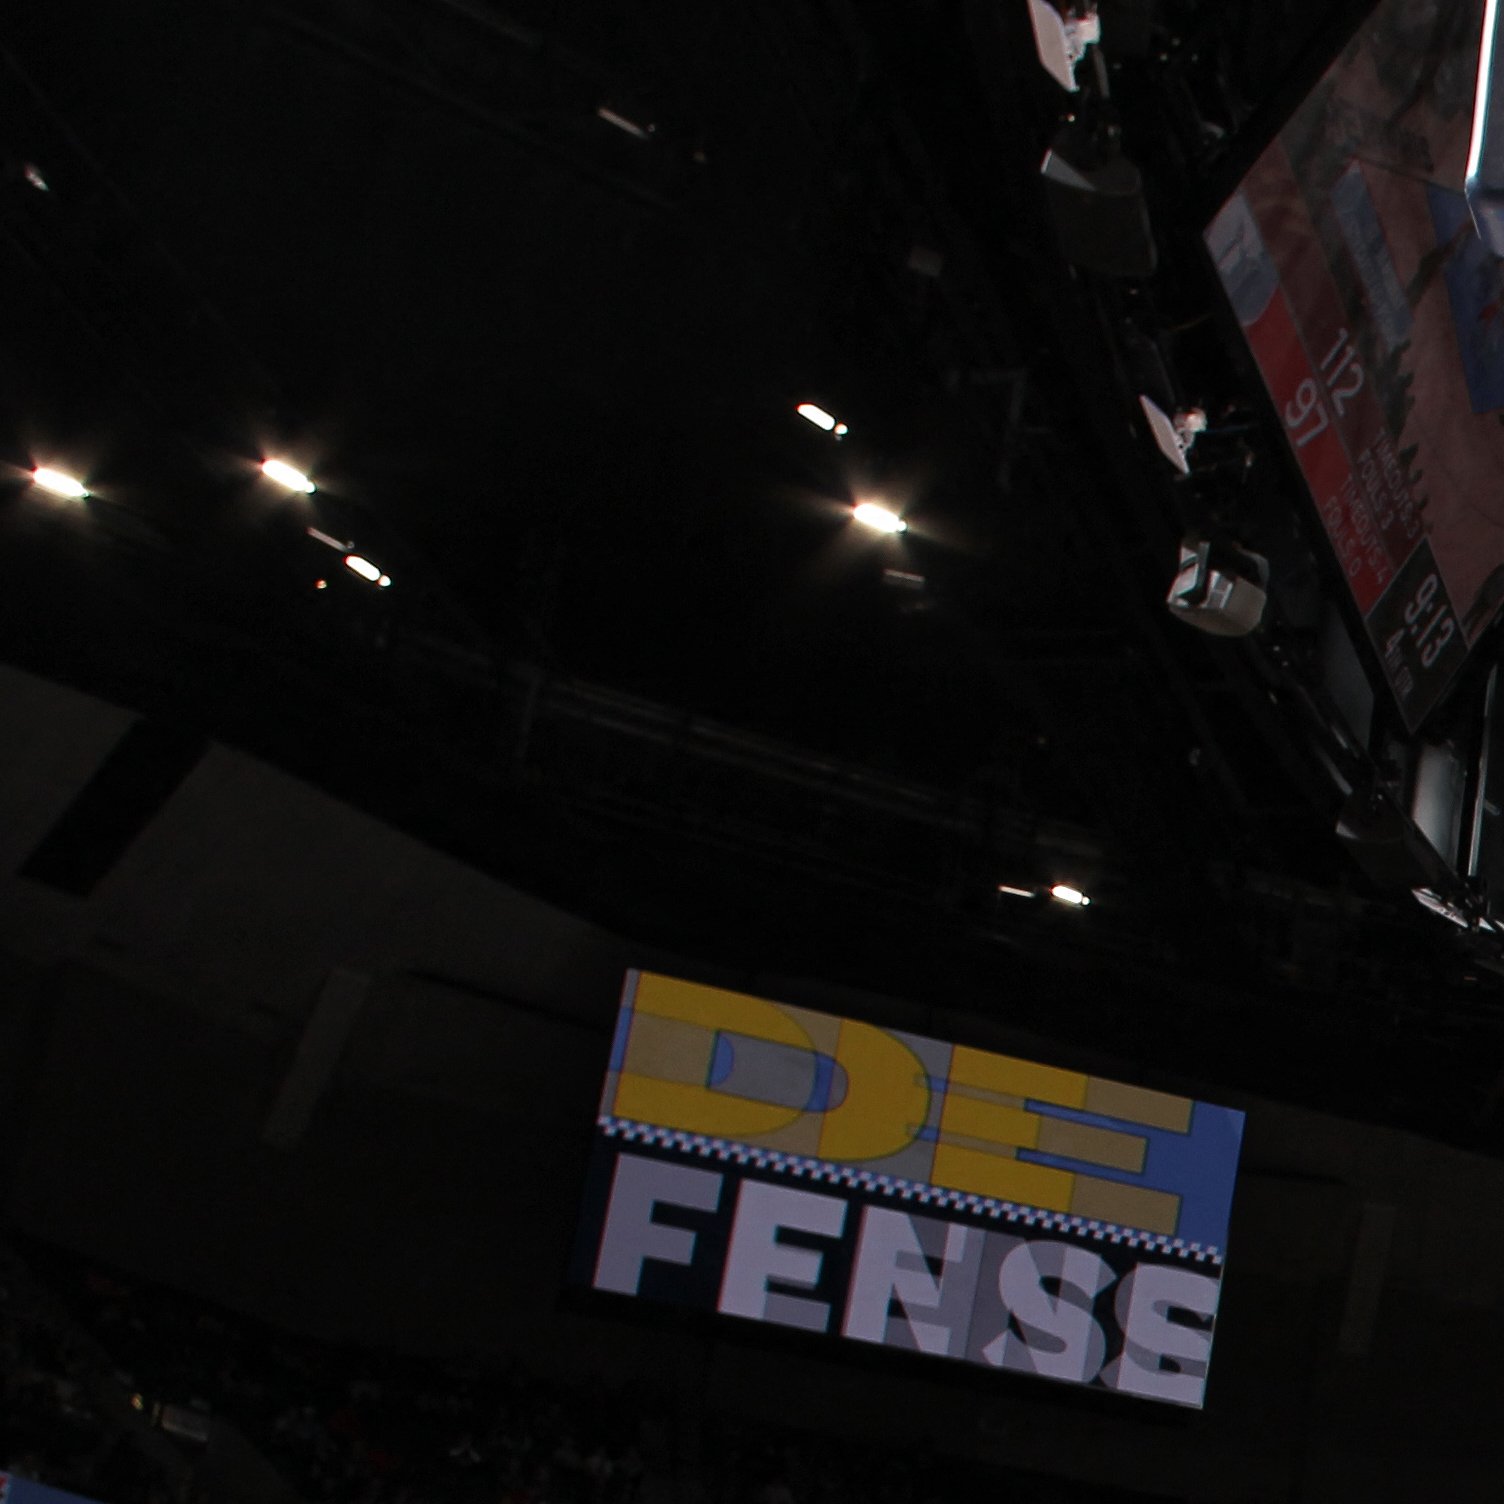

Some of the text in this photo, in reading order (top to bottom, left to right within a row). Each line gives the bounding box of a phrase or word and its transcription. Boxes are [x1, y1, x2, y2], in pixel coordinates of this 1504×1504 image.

[1285, 377, 1329, 447] 97
[1320, 327, 1365, 417] 112
[1404, 573, 1455, 670] 9:13
